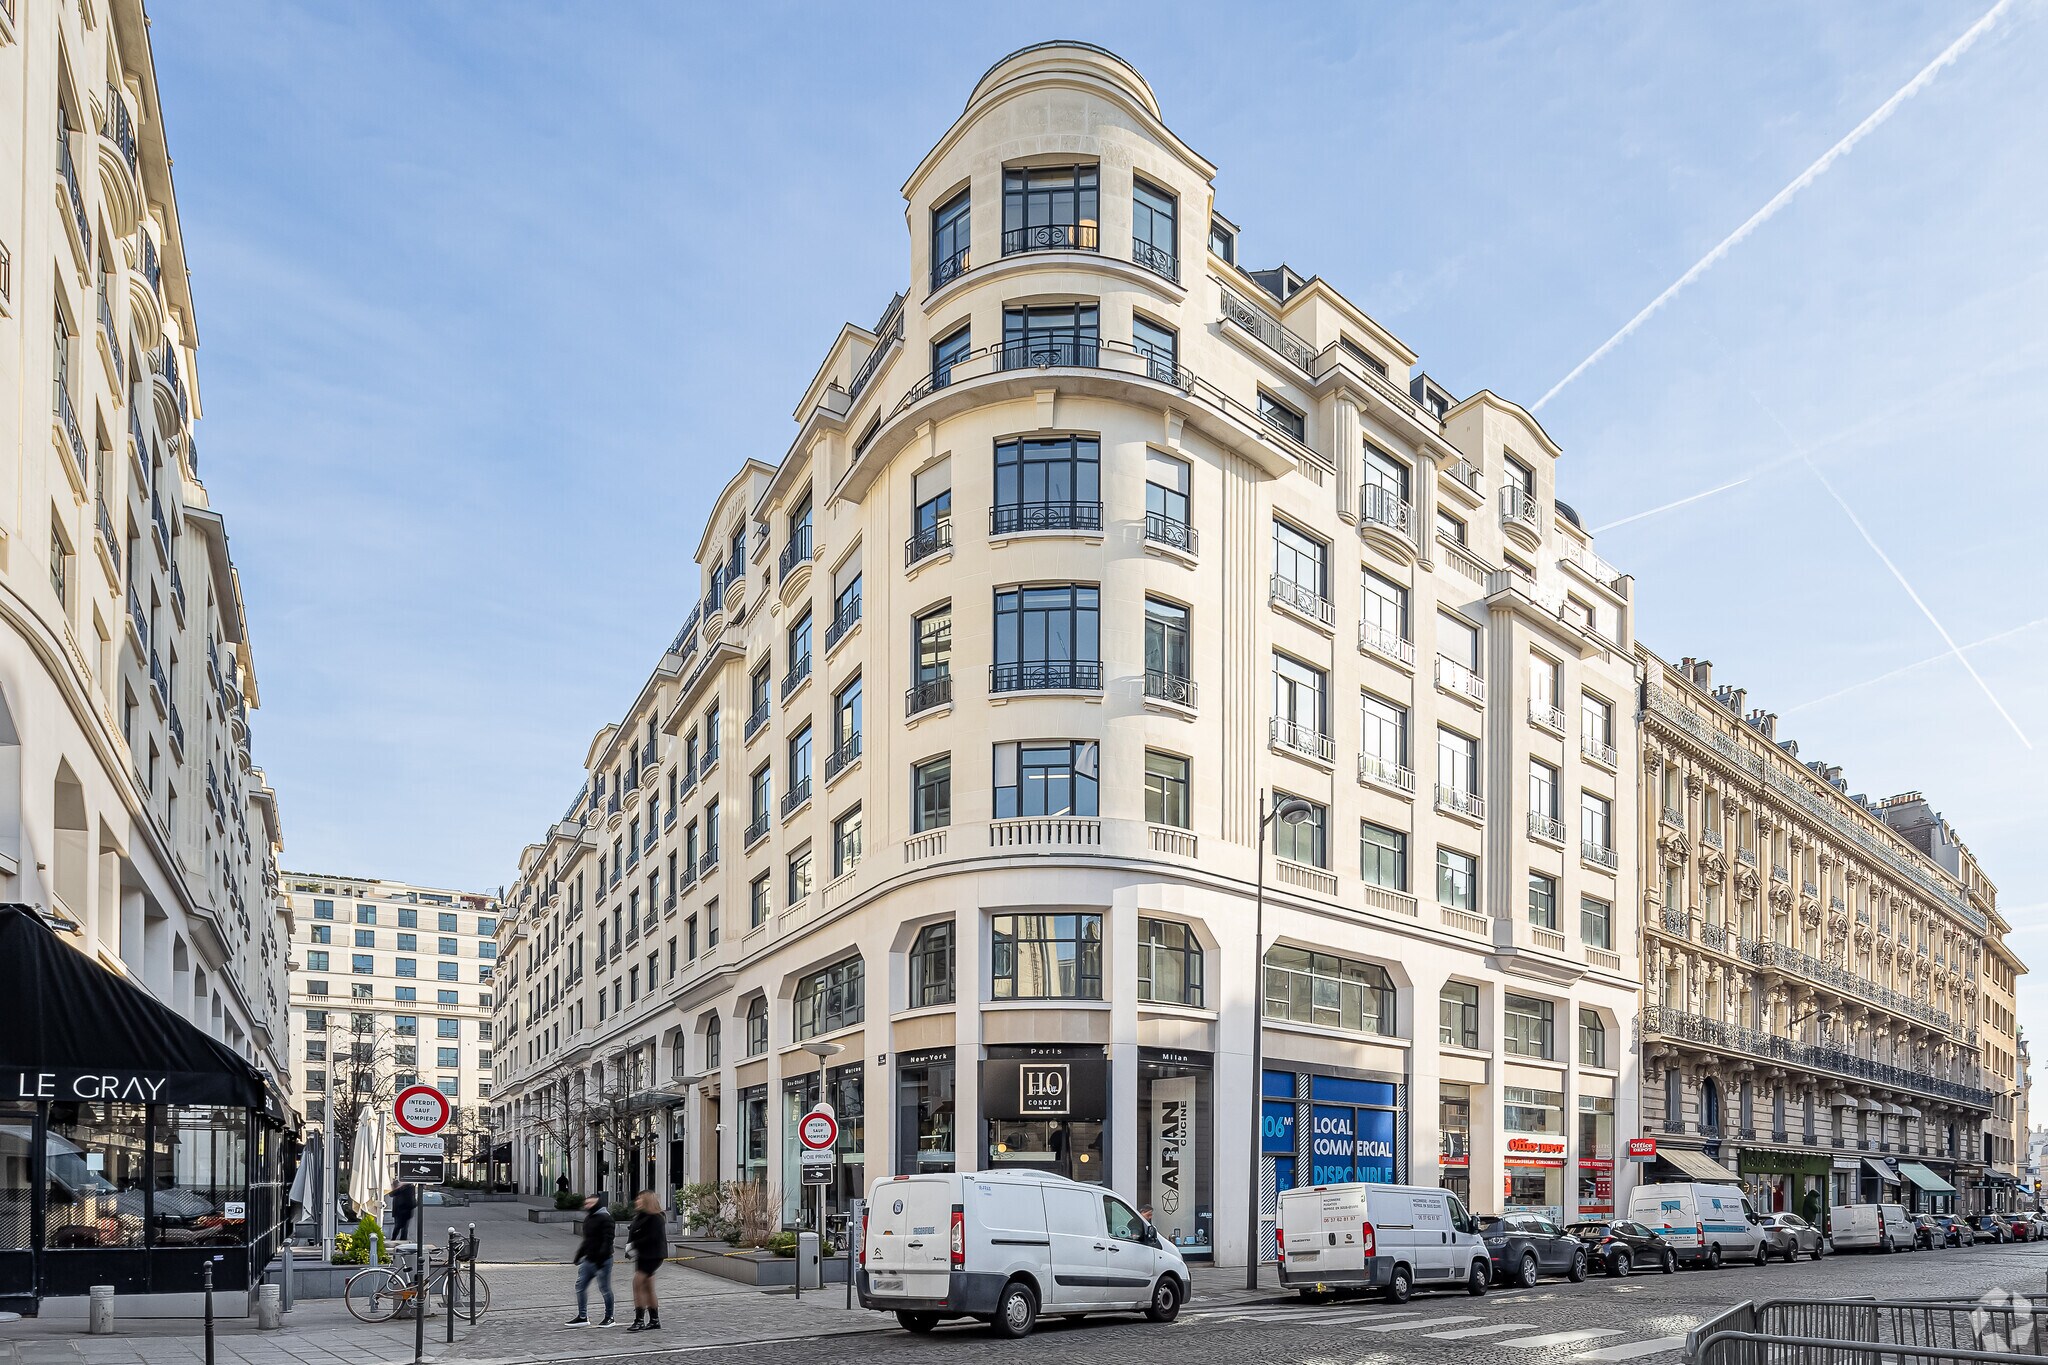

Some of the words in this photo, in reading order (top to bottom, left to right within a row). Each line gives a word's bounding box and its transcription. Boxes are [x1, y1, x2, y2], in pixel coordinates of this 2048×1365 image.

[910, 1053, 947, 1063] New-York
[1162, 1053, 1188, 1062] Milan
[19, 1073, 56, 1097] LE
[73, 1075, 166, 1100] GRAY
[1026, 1071, 1063, 1096] HO
[1314, 1117, 1353, 1135] LOCAL
[418, 1141, 443, 1150] PRIVÉE
[1161, 1101, 1180, 1191] ARAN
[1314, 1138, 1392, 1157] COMMERCIAL
[1507, 1137, 1538, 1152] Office
[1538, 1143, 1565, 1154] DEPOT
[1314, 1165, 1392, 1185] DISPONIBLE
